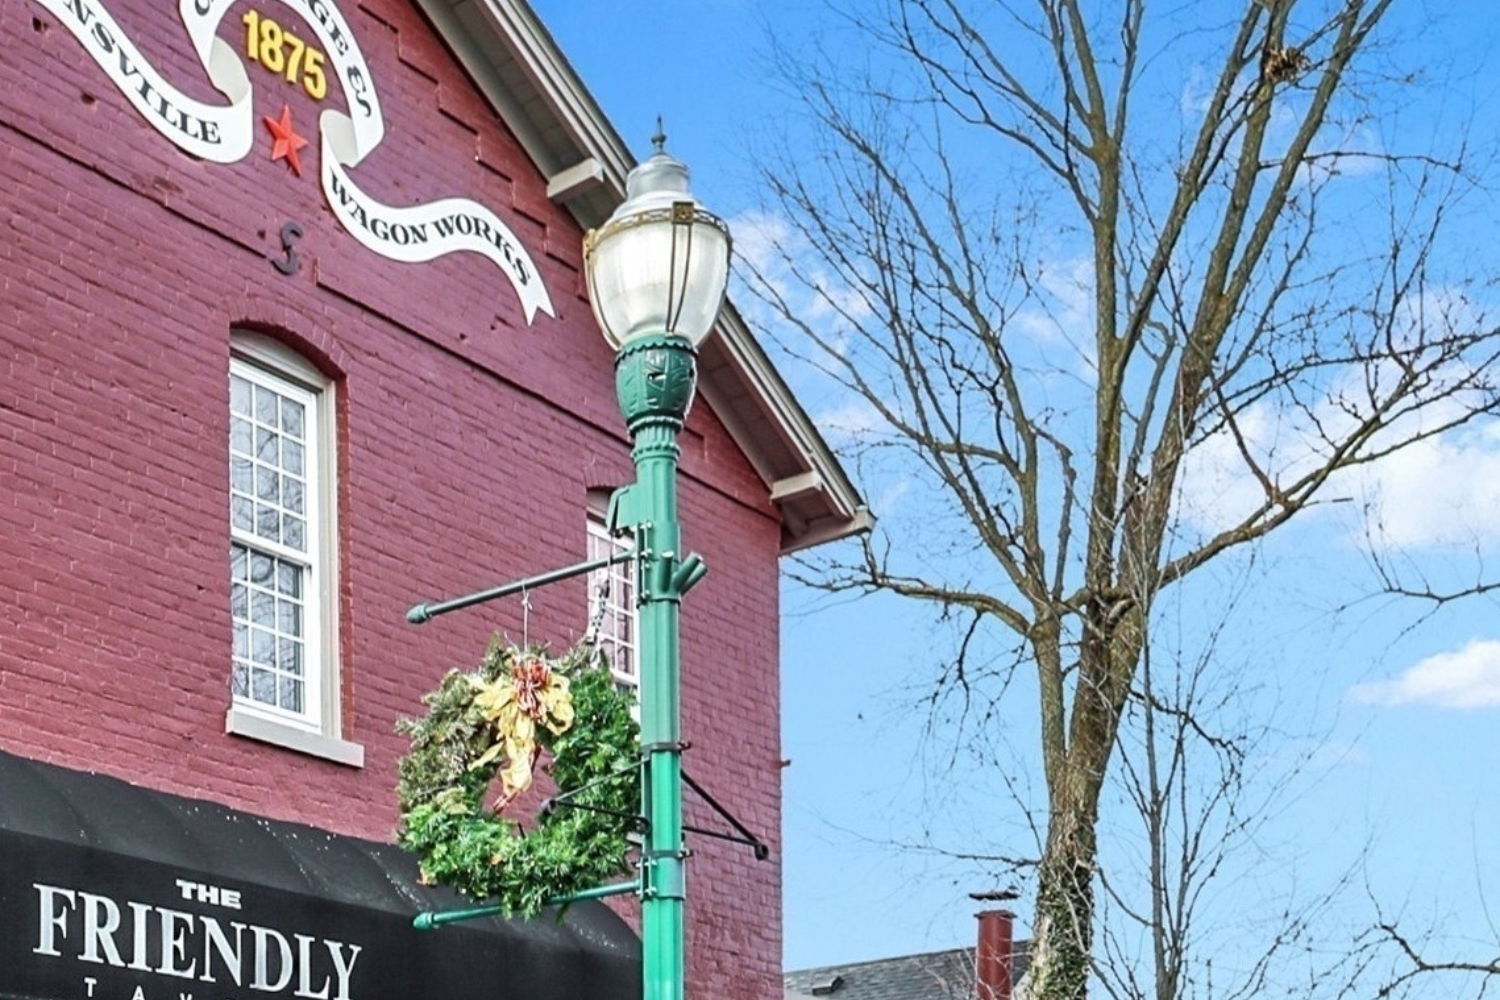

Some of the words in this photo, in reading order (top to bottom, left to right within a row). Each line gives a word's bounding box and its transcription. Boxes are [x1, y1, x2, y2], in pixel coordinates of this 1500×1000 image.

[243, 9, 327, 100] 1875
[329, 166, 429, 246] WAGON
[431, 213, 532, 287] WORKS
[176, 879, 242, 909] THE
